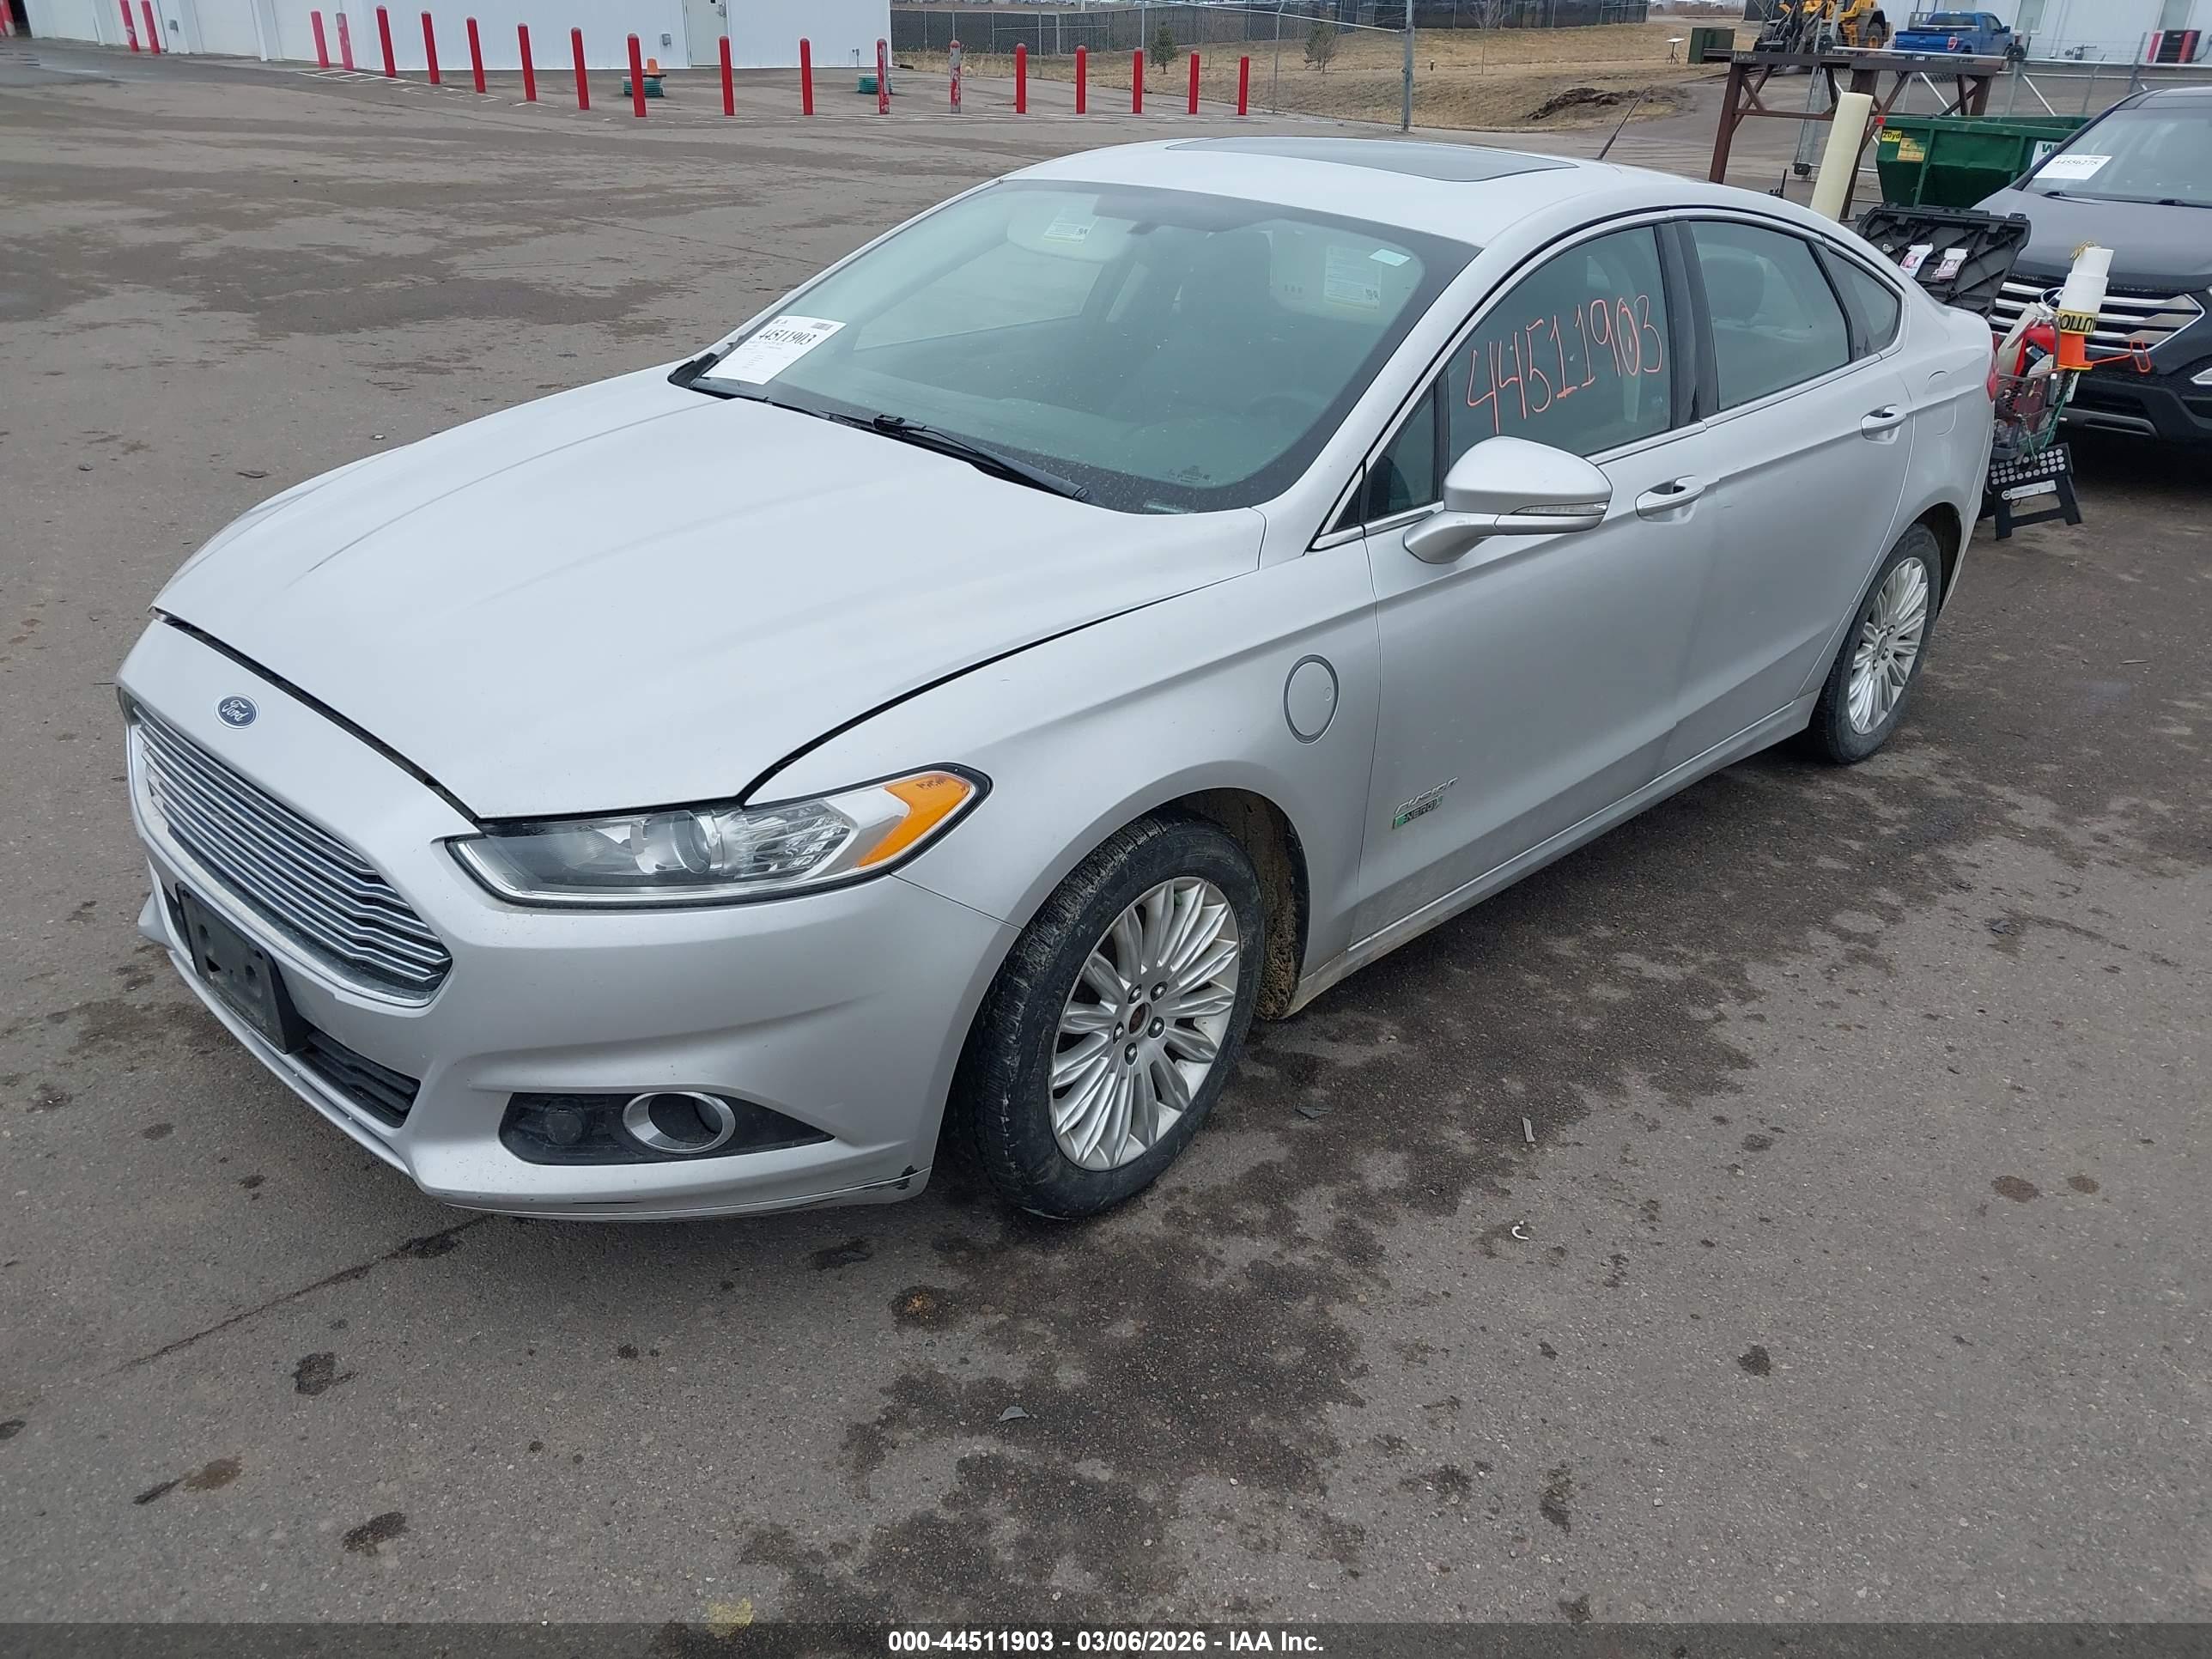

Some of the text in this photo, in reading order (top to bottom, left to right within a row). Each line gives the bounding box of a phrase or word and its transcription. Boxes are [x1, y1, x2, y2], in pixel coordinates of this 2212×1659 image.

[1882, 131, 1901, 141] 20yd
[758, 329, 817, 345] 44511903
[1466, 295, 1663, 435] 44511903
[221, 699, 250, 722] Ford
